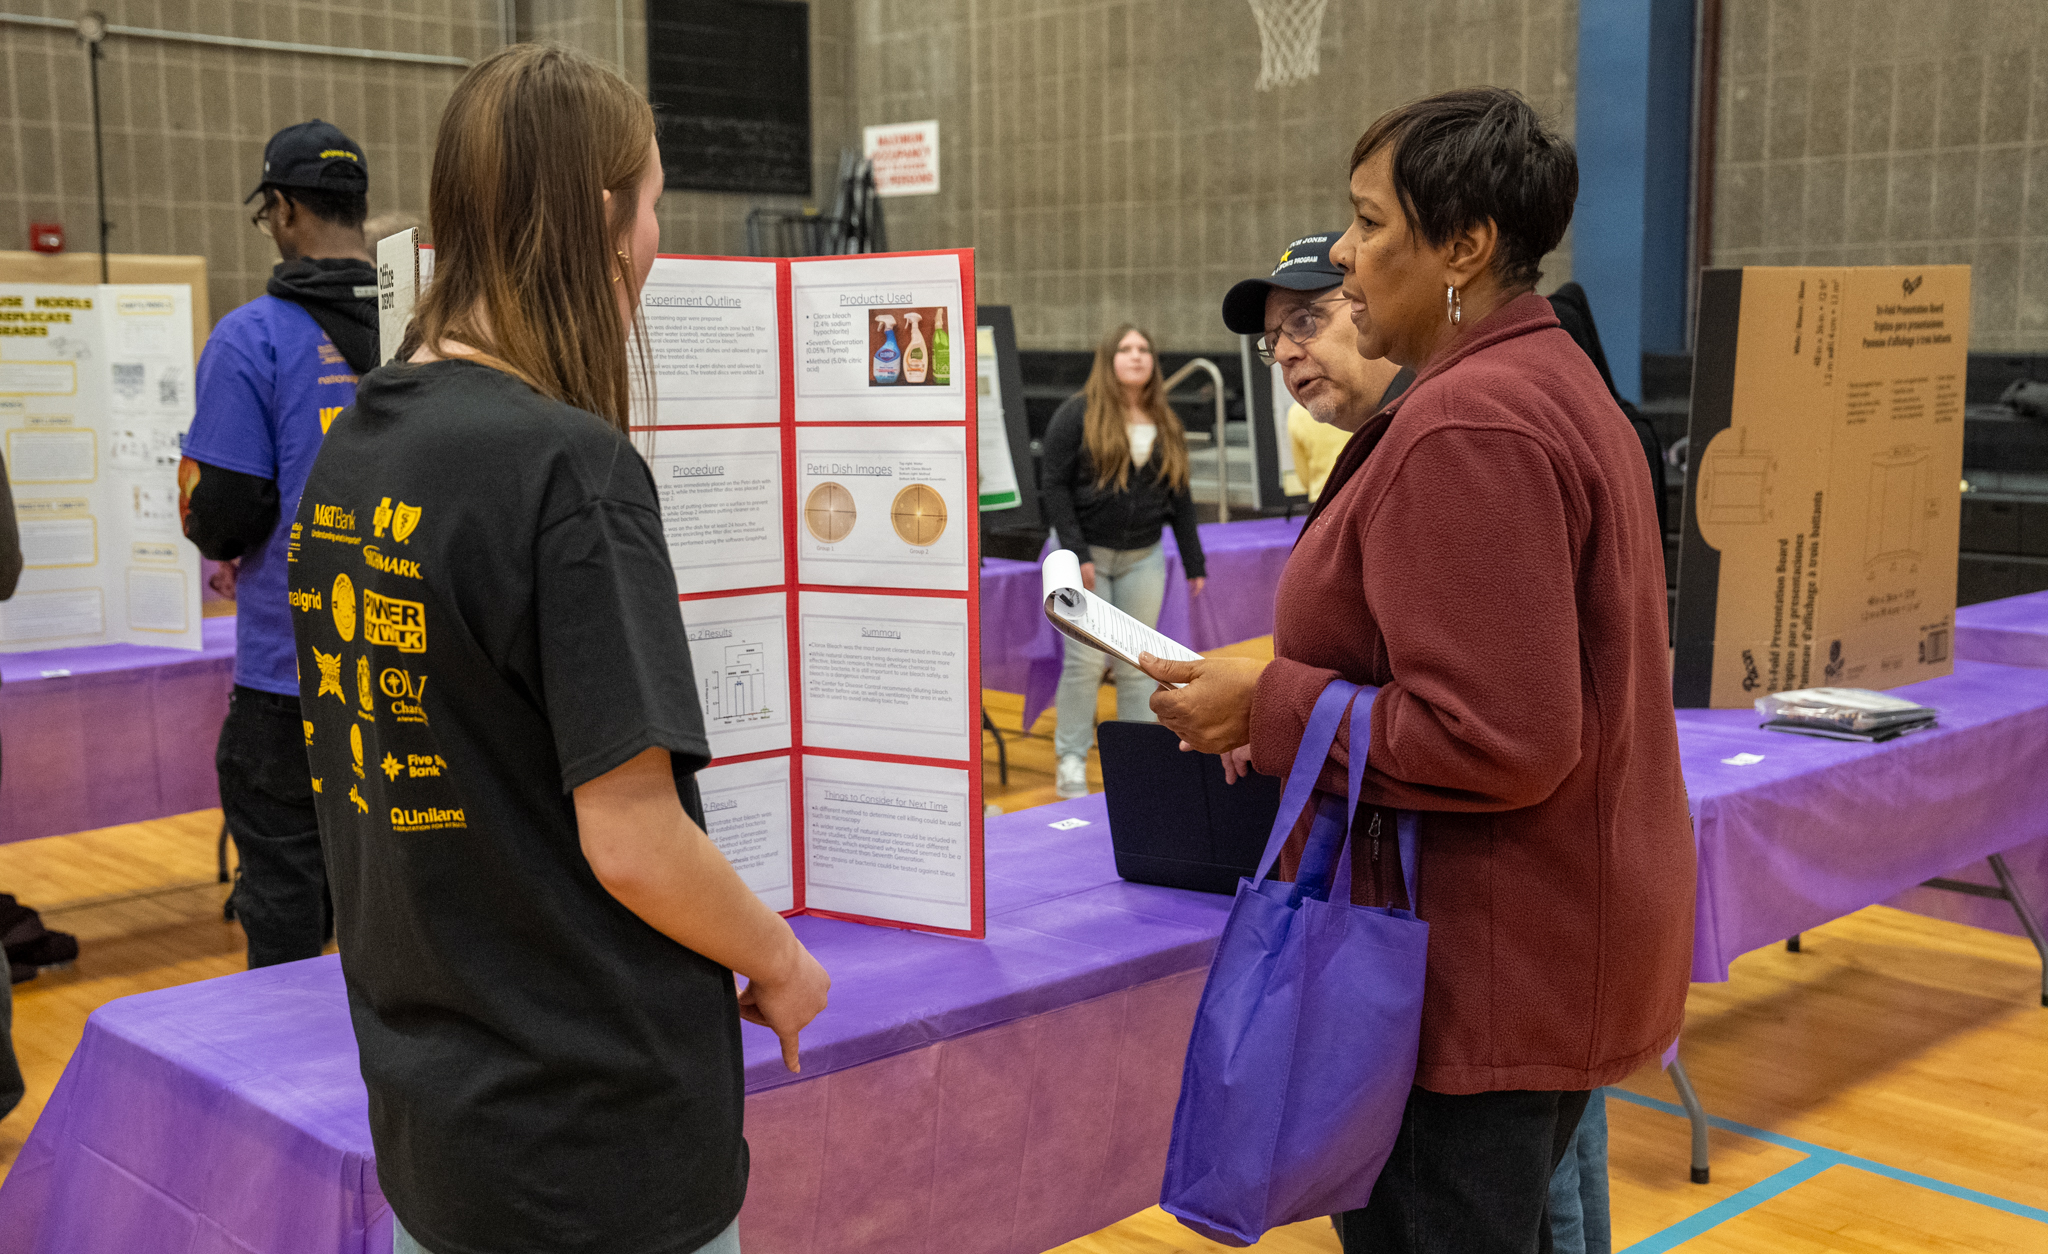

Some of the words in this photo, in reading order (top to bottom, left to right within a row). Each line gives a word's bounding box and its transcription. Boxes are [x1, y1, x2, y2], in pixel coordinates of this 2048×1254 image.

[379, 263, 394, 290] Office
[645, 294, 702, 306] Experiment
[705, 296, 741, 307] Outline
[840, 293, 884, 305] Products
[887, 292, 912, 303] Used
[673, 464, 724, 476] Procedure
[807, 463, 828, 474] Petri
[832, 463, 852, 474] Dish
[856, 464, 892, 476] Images
[1776, 539, 1789, 574] Board
[1790, 533, 1804, 619] presentaciones
[1770, 575, 1785, 648] Presentation
[698, 630, 702, 640] 2
[705, 629, 732, 639] Results
[862, 627, 901, 639] Summary
[1788, 622, 1798, 648] para
[408, 754, 433, 766] Five
[409, 765, 441, 778] Bank
[710, 800, 737, 810] Results
[824, 790, 848, 802] Things
[850, 792, 859, 800] to
[860, 794, 893, 805] Consider
[896, 797, 906, 806] for
[909, 799, 926, 808] Next
[929, 800, 948, 811] Time
[404, 808, 466, 825] Uniland
